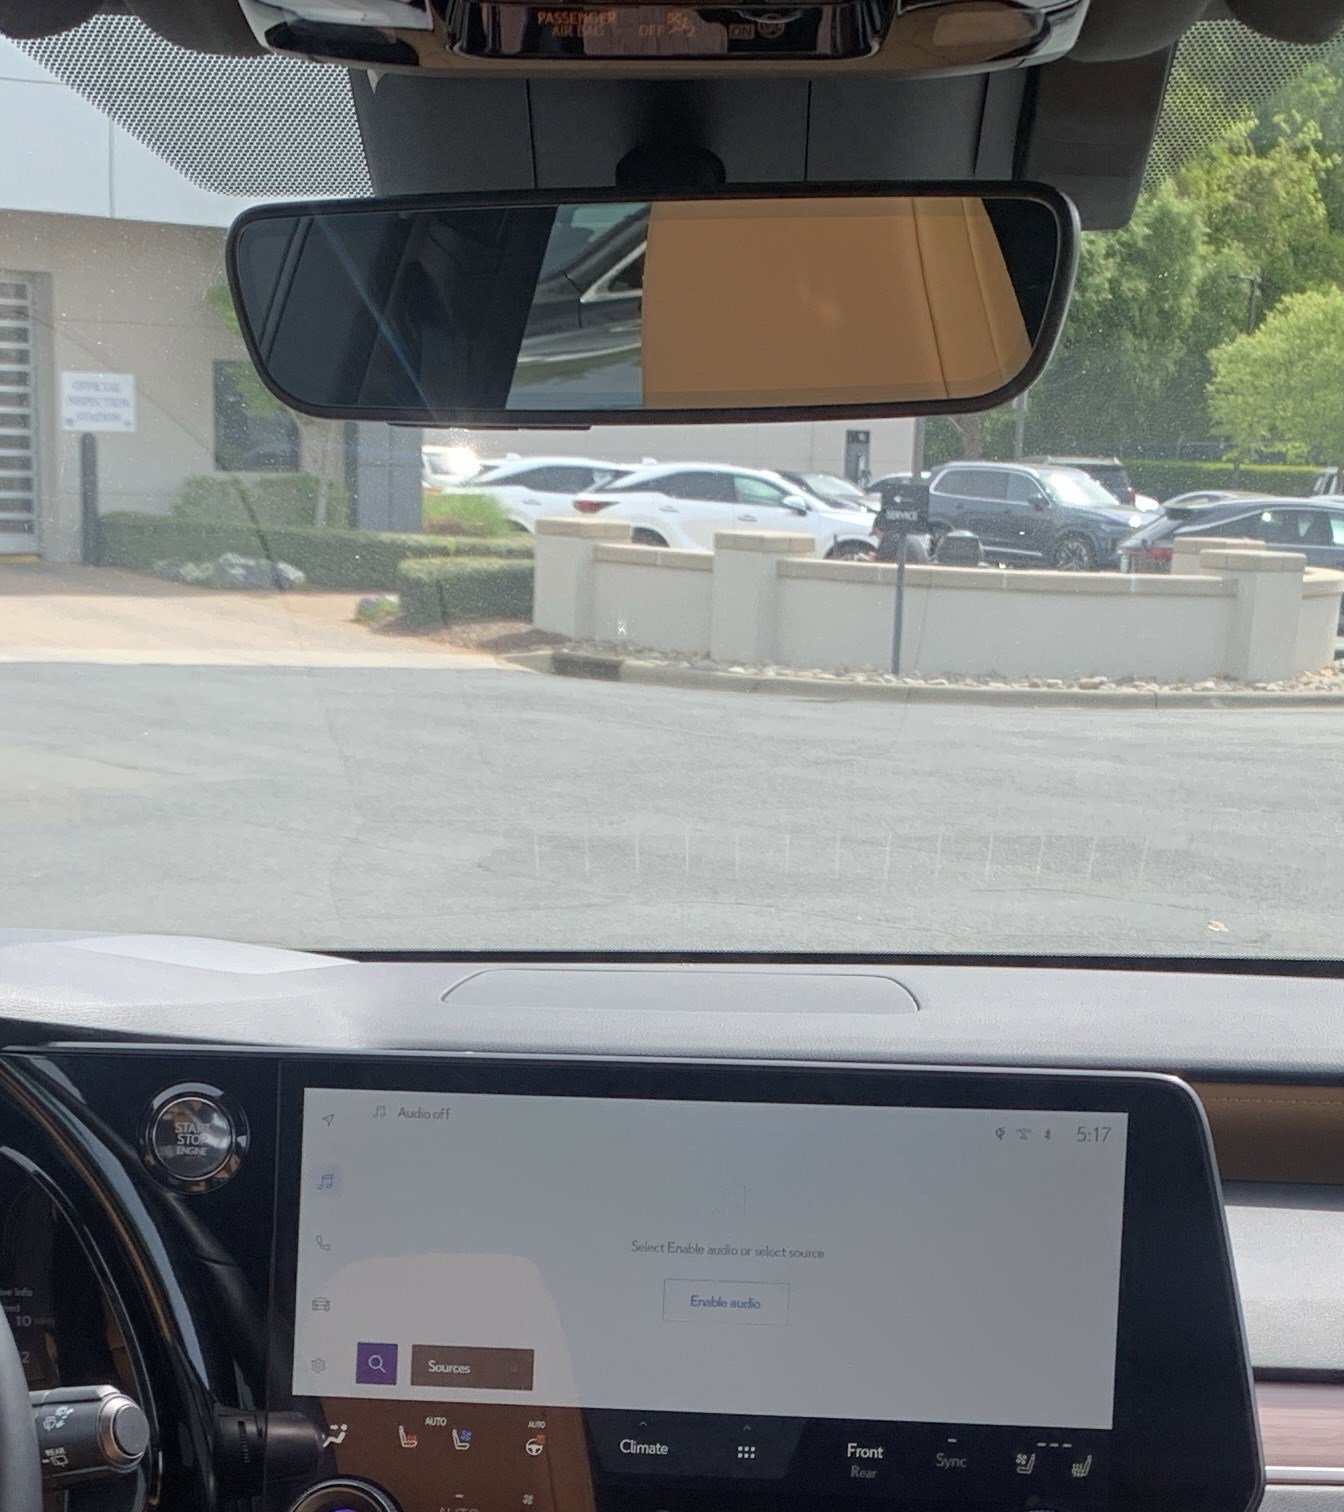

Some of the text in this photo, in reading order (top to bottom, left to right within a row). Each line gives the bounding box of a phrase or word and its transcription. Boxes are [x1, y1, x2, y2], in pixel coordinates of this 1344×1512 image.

[397, 1106, 451, 1120] Audio off
[1076, 1124, 1112, 1144] 5:17
[176, 1145, 208, 1156] ENGINE
[631, 1240, 825, 1260] Select Enable audio or select source
[690, 1294, 761, 1310] Enable audio
[427, 1361, 471, 1375] Sources
[425, 1416, 447, 1427] AUTO
[528, 1420, 546, 1429] AUTO
[619, 1439, 669, 1456] Climate
[846, 1443, 884, 1461] Front
[935, 1452, 968, 1470] Sync
[851, 1465, 878, 1480] Rear
